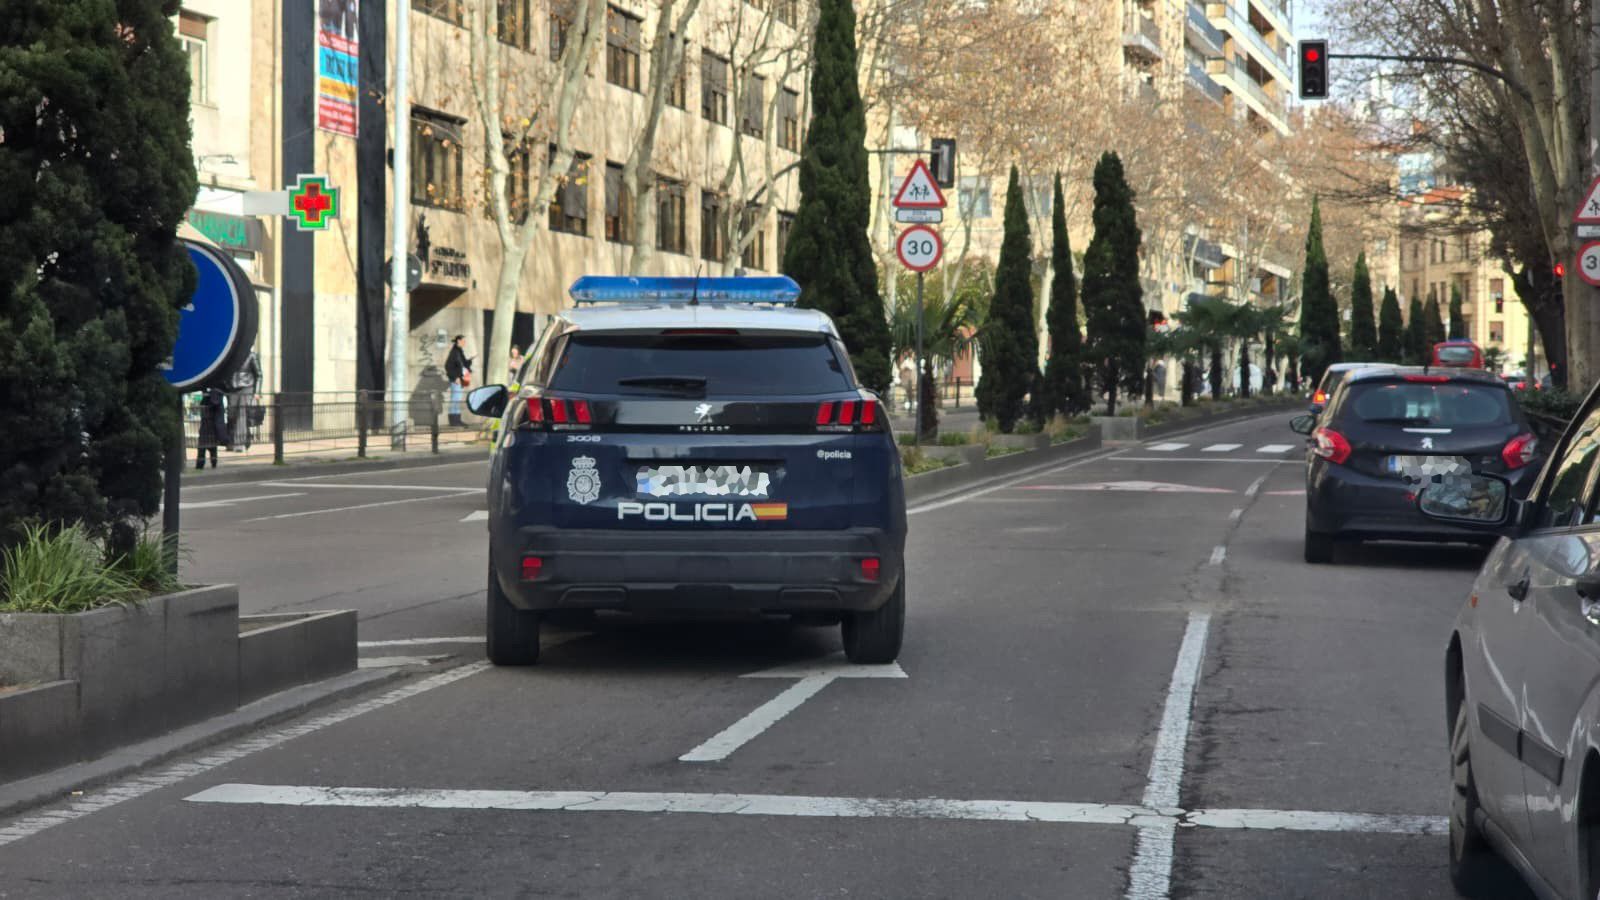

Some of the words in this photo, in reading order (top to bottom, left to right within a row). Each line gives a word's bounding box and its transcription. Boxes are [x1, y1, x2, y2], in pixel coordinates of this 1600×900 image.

[908, 240, 933, 255] 30
[1586, 255, 1600, 269] 3
[816, 449, 852, 460] @policia
[617, 502, 757, 521] POLICIA
